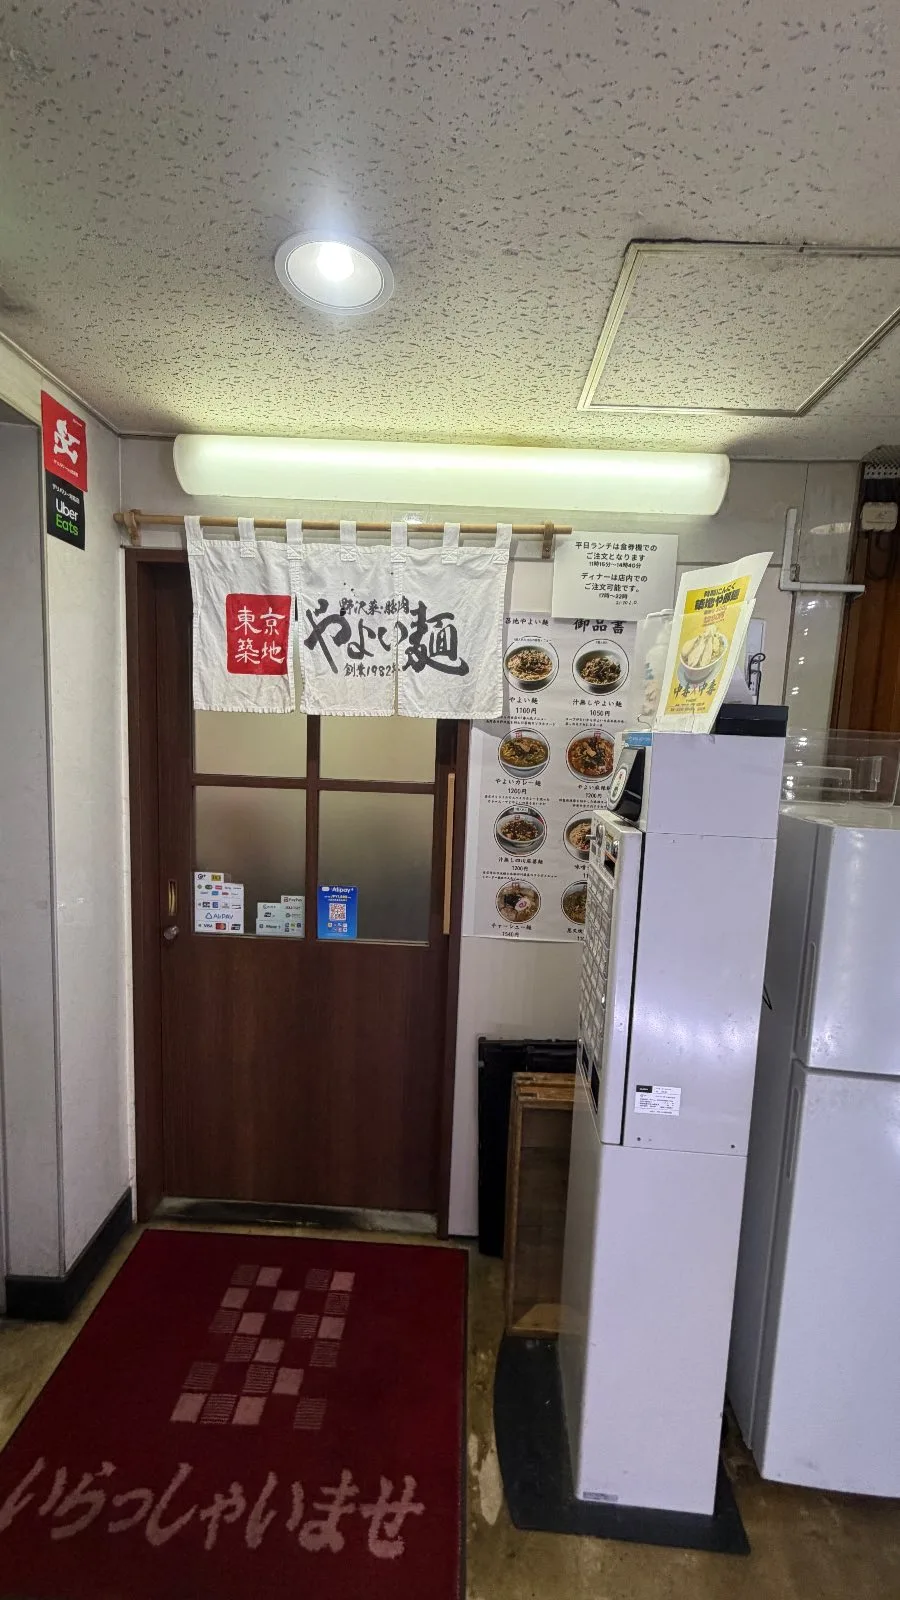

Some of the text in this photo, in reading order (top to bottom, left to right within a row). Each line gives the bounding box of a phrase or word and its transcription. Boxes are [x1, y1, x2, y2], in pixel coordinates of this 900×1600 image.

[56, 497, 78, 522] Uber
[56, 513, 79, 536] Eats
[575, 541, 658, 552] 平日ランチは食券機での
[586, 552, 646, 562] ご注文となります
[581, 572, 648, 583] ディナーは店内での
[584, 583, 640, 593] ご注文可能です。
[234, 605, 286, 637] 東京
[572, 618, 627, 635] 御品書
[235, 638, 286, 666] 築地
[0, 1456, 426, 1560] いらっしゃいませ
